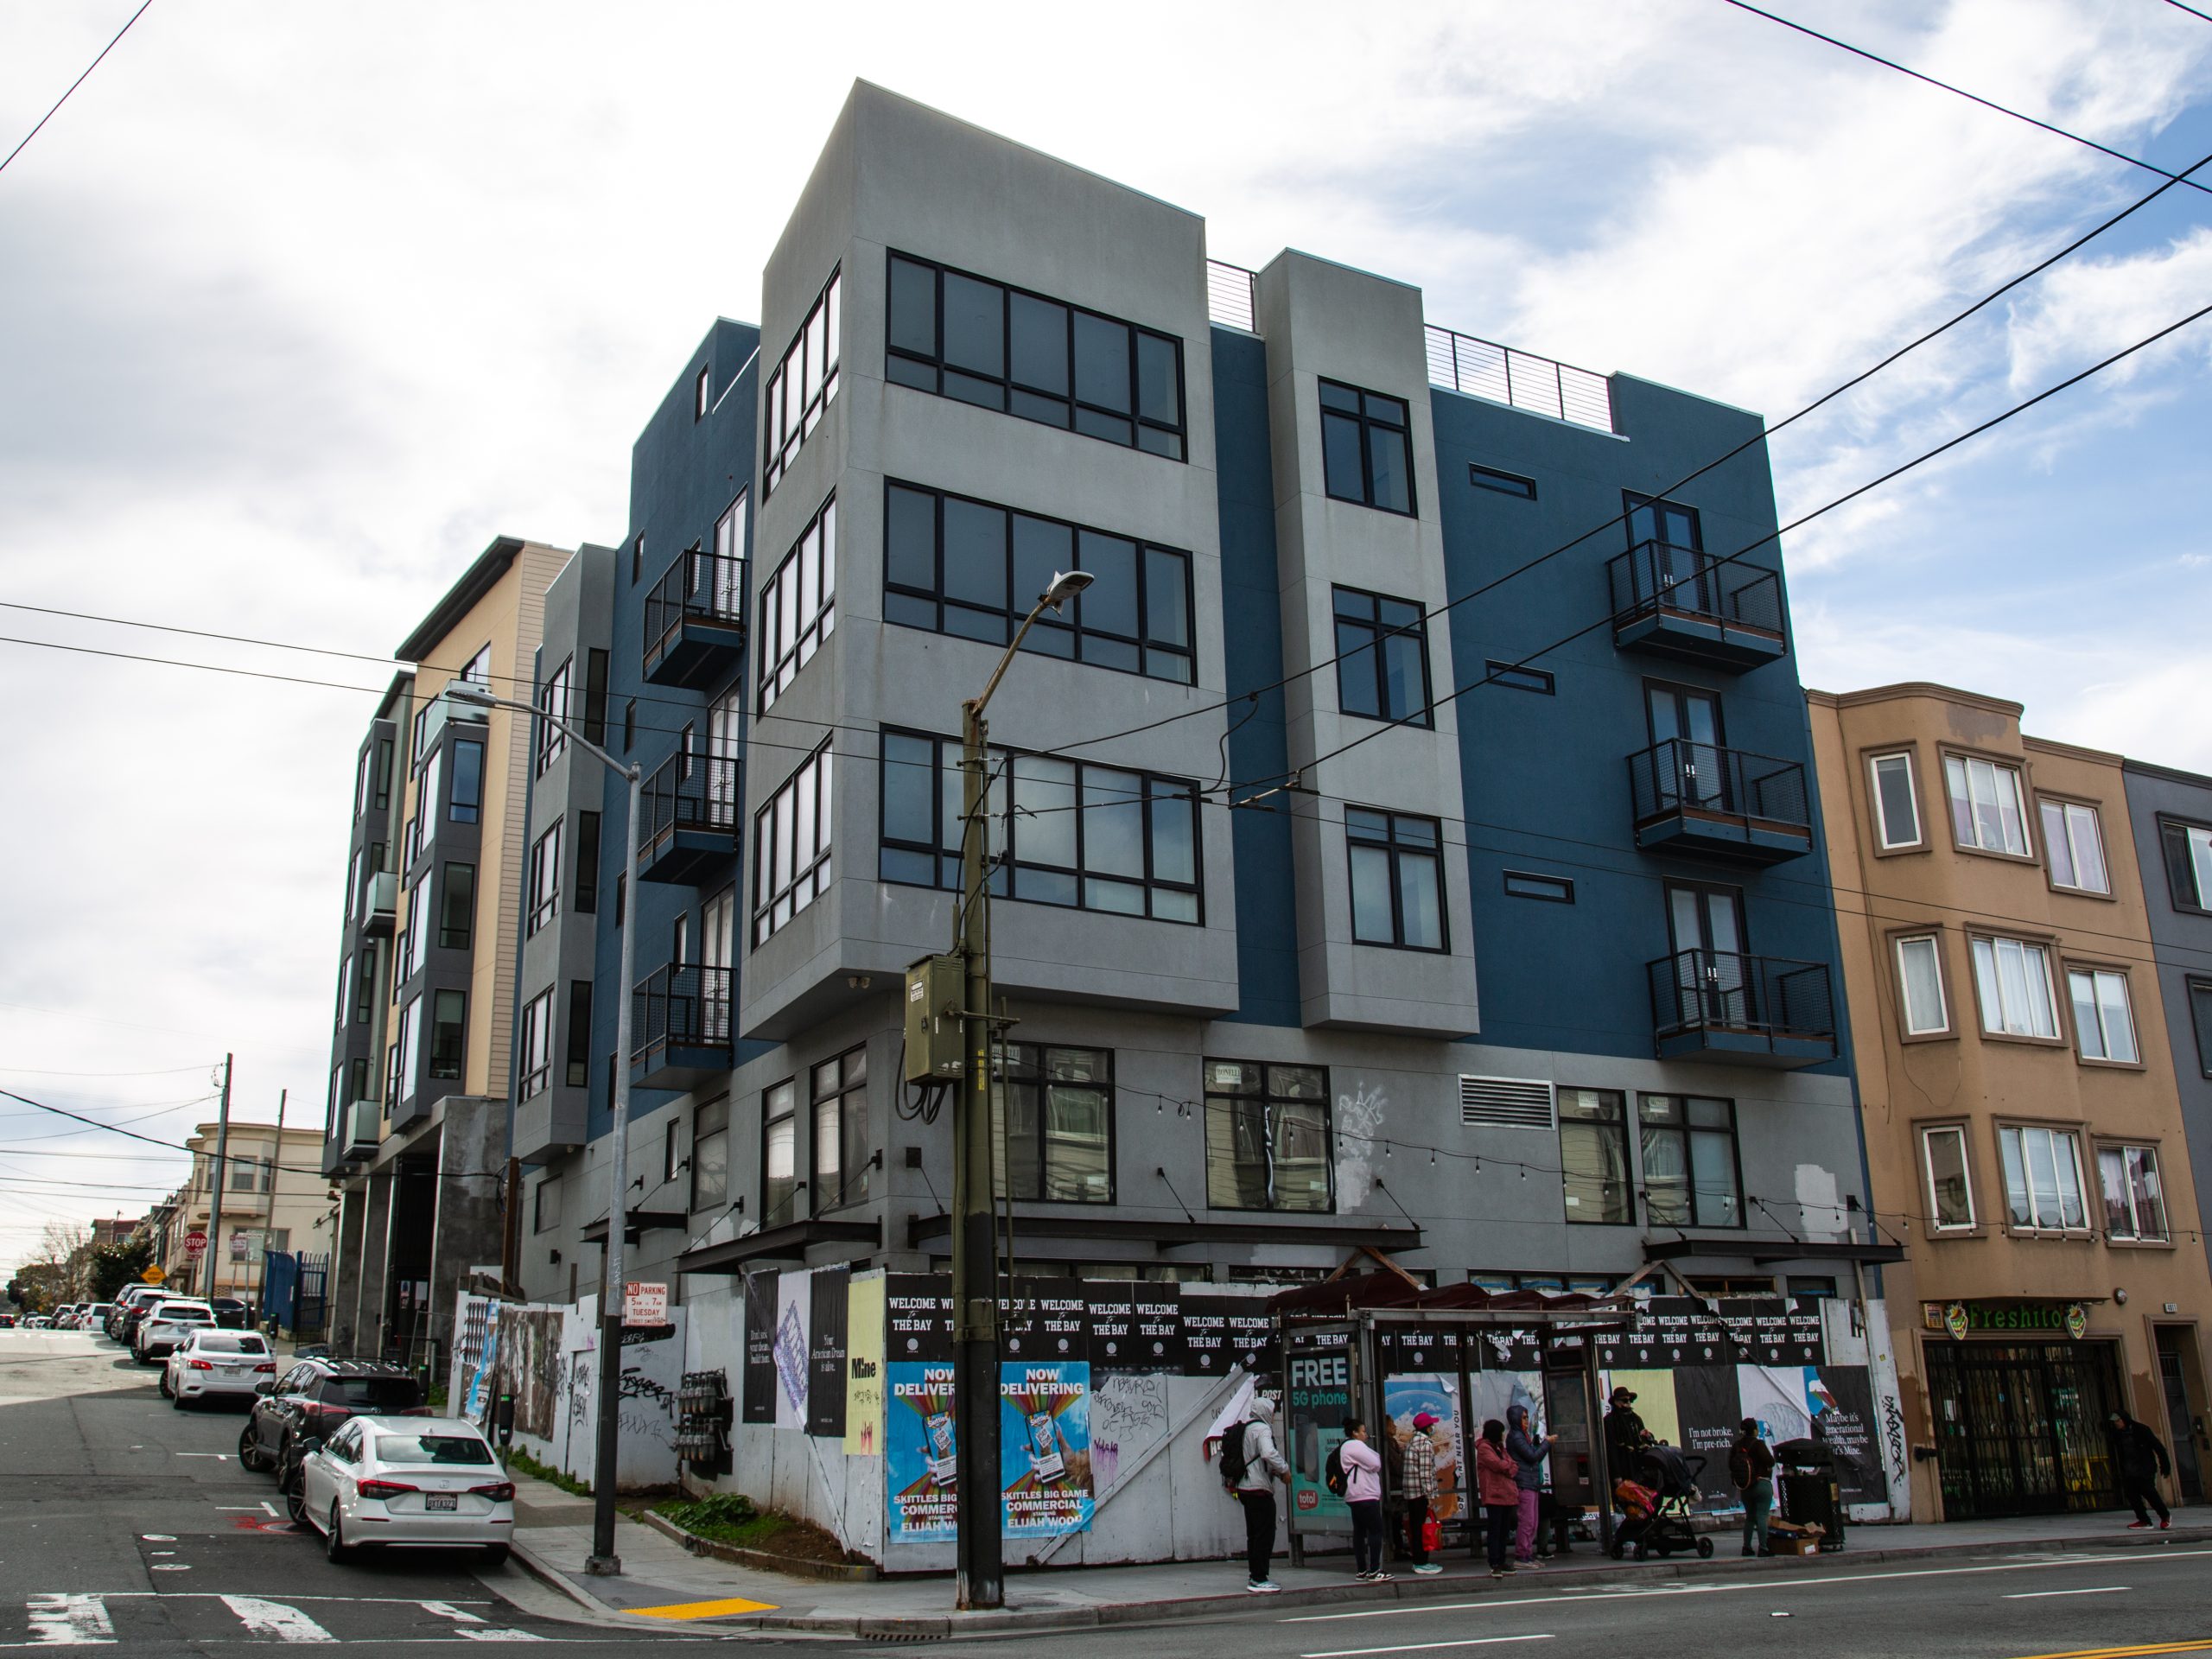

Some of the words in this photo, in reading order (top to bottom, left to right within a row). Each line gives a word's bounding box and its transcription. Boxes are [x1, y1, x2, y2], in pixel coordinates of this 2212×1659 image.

[186, 1238, 207, 1247] STOP
[627, 1283, 639, 1294] NO
[640, 1287, 665, 1295] PARKING
[889, 1298, 936, 1309] WELCOME
[1040, 1299, 1084, 1311] WELCOME
[1089, 1303, 1131, 1315] WELCOME
[1136, 1303, 1179, 1315] WELCOME
[1184, 1316, 1224, 1327] WELCOME
[1658, 1316, 1688, 1325] WELCOME
[1756, 1317, 1787, 1326] WELCOME
[1789, 1316, 1820, 1325] WELCOME
[1969, 1304, 2063, 1328] Freshito
[893, 1319, 912, 1331] THE
[913, 1319, 932, 1331] BAY
[1045, 1320, 1063, 1332] THE
[1064, 1320, 1080, 1332] BAY
[1229, 1317, 1269, 1329] WELCOME
[1093, 1325, 1111, 1336] THE
[1112, 1325, 1128, 1336] BAY
[1140, 1325, 1159, 1336] THE
[1159, 1325, 1175, 1336] BAY
[1187, 1337, 1205, 1348] THE
[1205, 1337, 1222, 1348] BAY
[1233, 1338, 1250, 1348] THE
[1251, 1337, 1267, 1348] BAY
[1316, 1335, 1332, 1345] THE
[1333, 1334, 1348, 1344] BAY
[1402, 1336, 1418, 1345] THE
[1418, 1336, 1433, 1345] BAY
[1522, 1335, 1535, 1344] THE
[1593, 1334, 1607, 1344] THE
[1607, 1334, 1620, 1344] BAY
[1629, 1334, 1643, 1344] THE
[1643, 1334, 1655, 1344] BAY
[1662, 1334, 1675, 1344] THE
[1675, 1334, 1687, 1344] BAY
[1694, 1332, 1707, 1342] THE
[1707, 1332, 1719, 1342] BAY
[1760, 1334, 1773, 1344] THE
[1774, 1334, 1785, 1343] BAY
[1793, 1333, 1807, 1342] THE
[1807, 1333, 1819, 1342] BAY
[811, 1347, 831, 1359] American
[831, 1347, 845, 1358] Dream
[852, 1357, 876, 1378] Mine
[1292, 1357, 1347, 1387] FREE
[1027, 1369, 1059, 1381] NOW
[1001, 1382, 1084, 1395] DELIVERING
[1293, 1391, 1308, 1406] 5G
[1312, 1390, 1347, 1408] phone
[1825, 1413, 1848, 1424] Maybe
[1849, 1412, 1859, 1422] it's
[1688, 1427, 1700, 1438] I'm
[1700, 1428, 1712, 1438] not
[1712, 1426, 1733, 1438] broke,
[1825, 1423, 1864, 1435] generational
[1692, 1439, 1703, 1449] I'm
[1703, 1438, 1732, 1451] pre-rich.
[1847, 1434, 1869, 1446] maybe
[1844, 1445, 1862, 1455] Mine.
[893, 1495, 939, 1503] SKITTLES
[941, 1494, 957, 1503] BIG
[1001, 1491, 1042, 1501] SKITTLES
[1044, 1491, 1059, 1499] BIG
[1061, 1489, 1089, 1498] GAME
[1300, 1493, 1315, 1503] total
[1006, 1499, 1084, 1512] COMMERCIAL
[901, 1521, 940, 1532] ELIJAH
[1007, 1517, 1045, 1529] ELIJAH
[1046, 1515, 1083, 1526] WOOD
